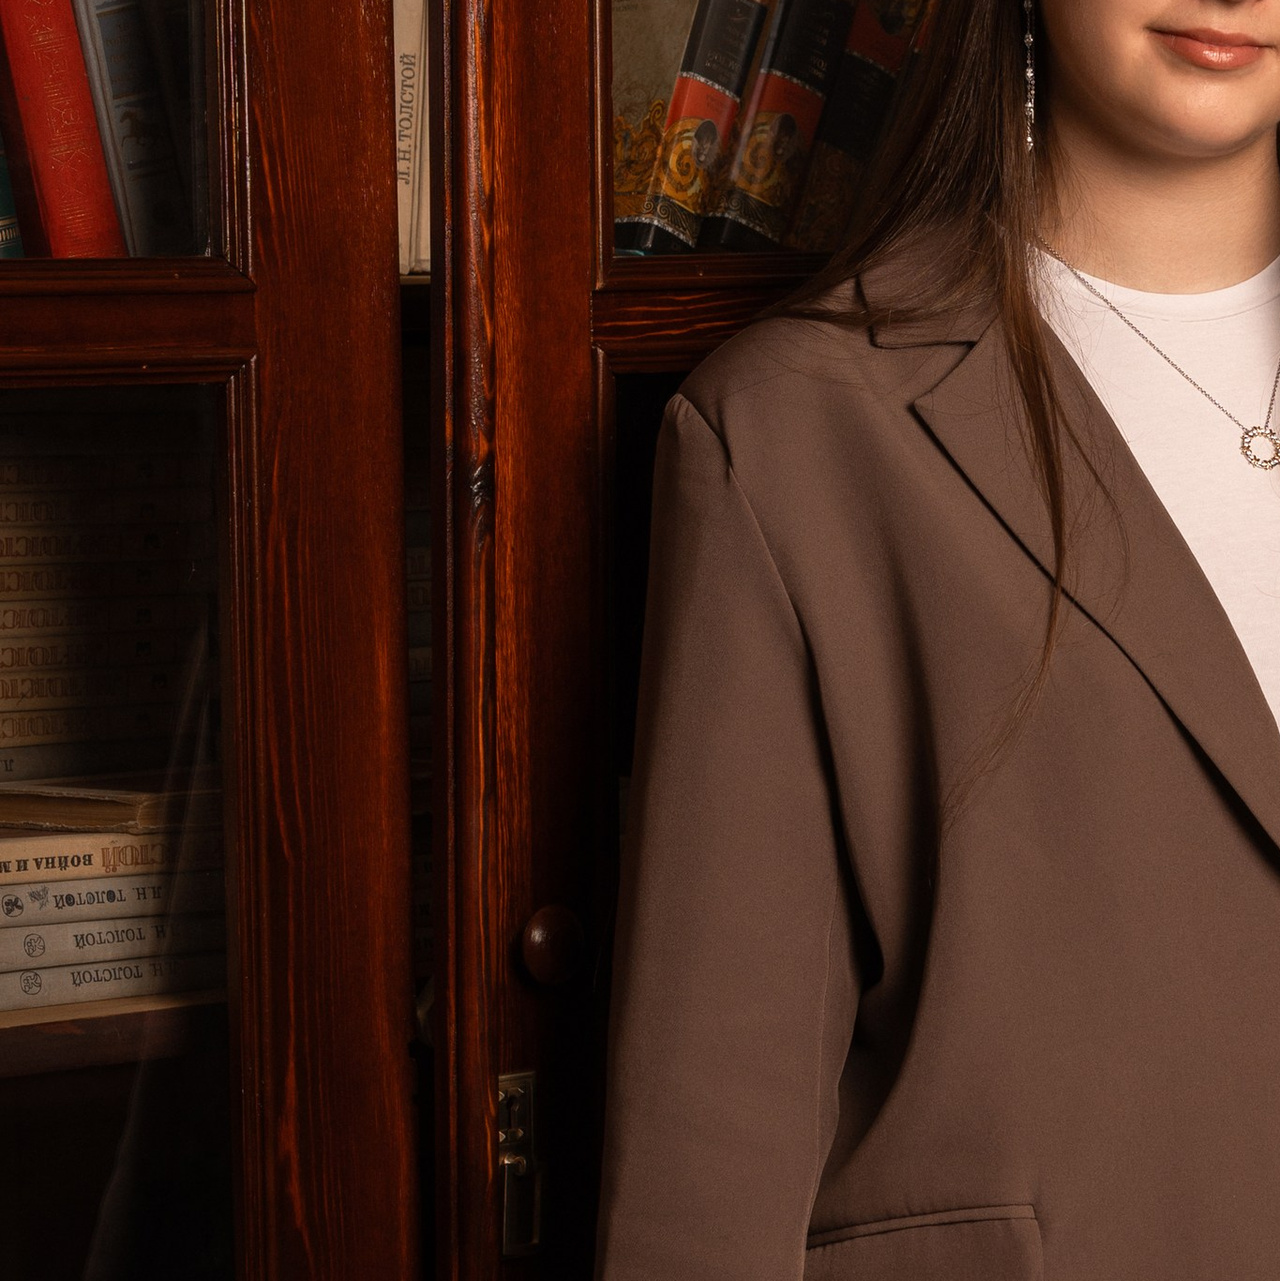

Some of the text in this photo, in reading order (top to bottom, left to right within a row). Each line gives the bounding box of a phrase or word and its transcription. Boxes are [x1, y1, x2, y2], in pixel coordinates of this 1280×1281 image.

[16, 859, 29, 872] И
[33, 853, 93, 871] ВОЙНА
[53, 889, 125, 909] ТОЛСТОЙ
[73, 928, 145, 949] ТОЛСТОЙ
[70, 965, 142, 986] ТОЛСТОЙ
